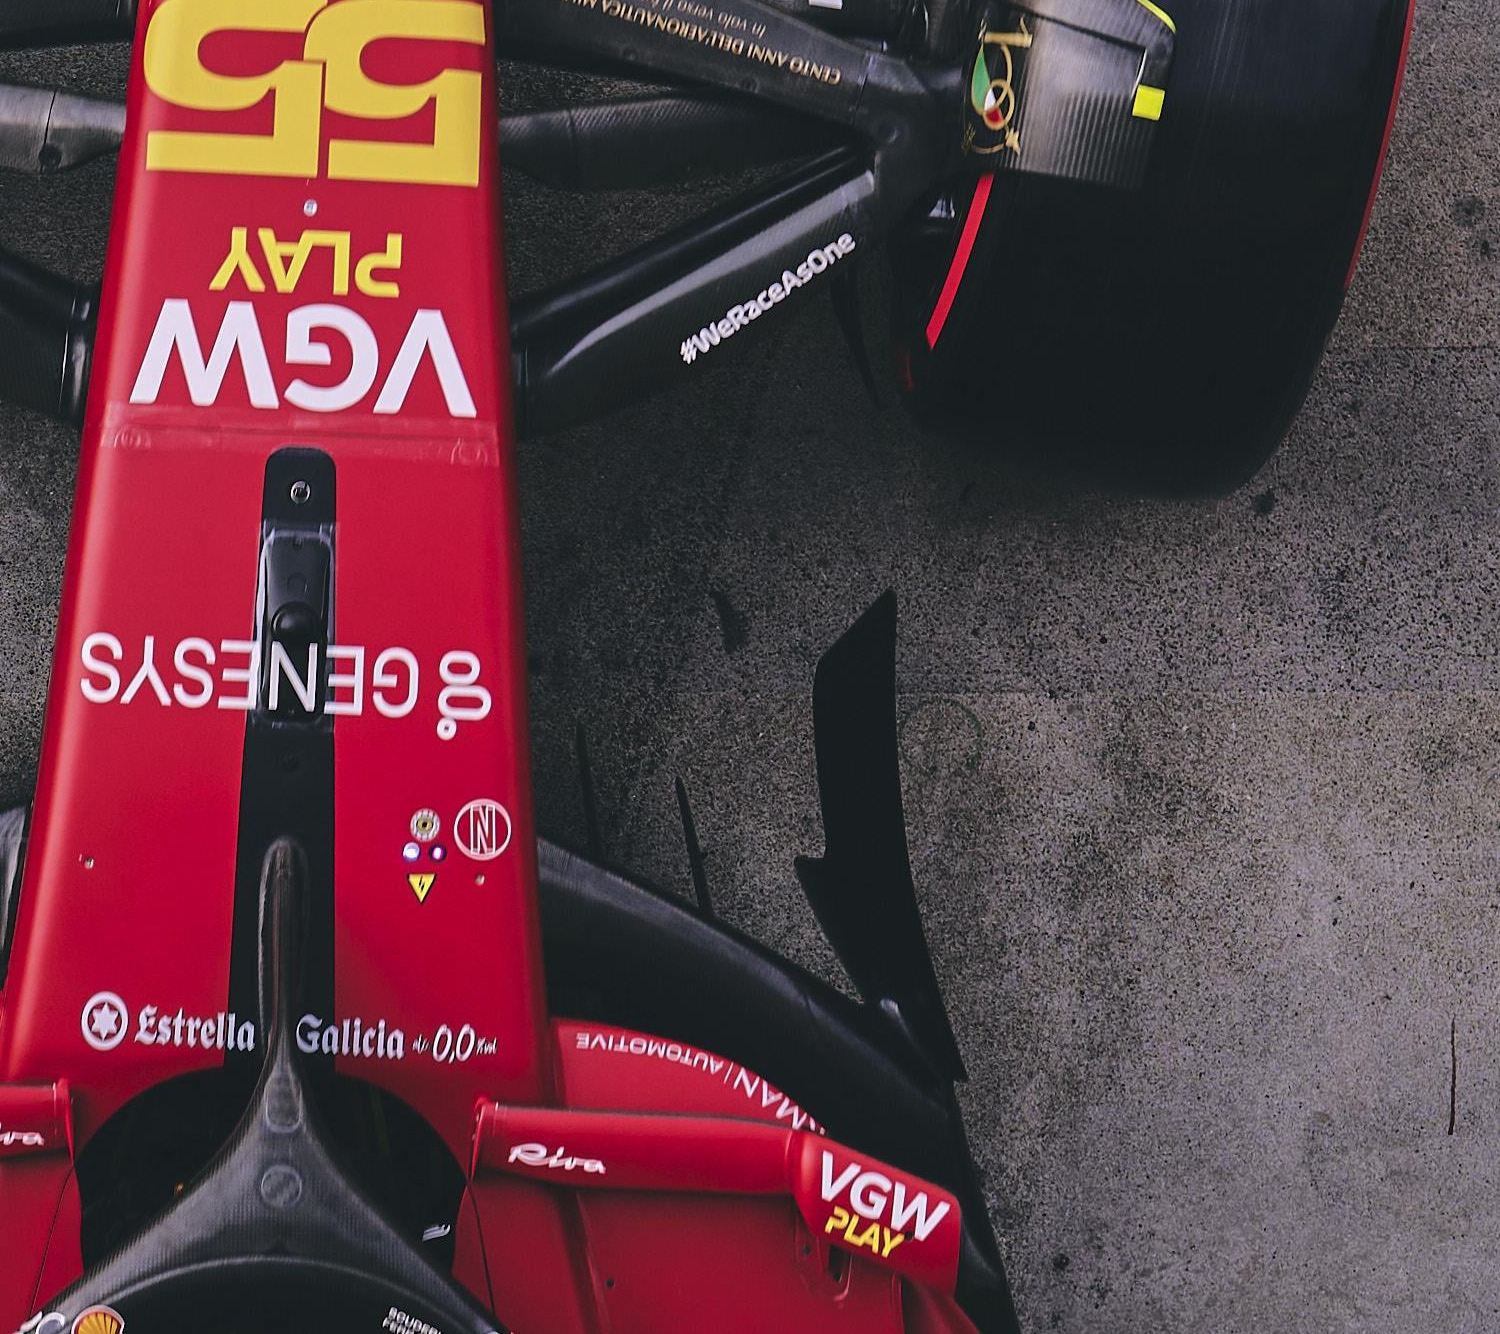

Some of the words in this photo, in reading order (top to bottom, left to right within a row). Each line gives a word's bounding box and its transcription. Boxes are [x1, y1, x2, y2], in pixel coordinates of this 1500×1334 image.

[747, 45, 789, 69] ANNI
[788, 55, 842, 86] CENTO
[209, 226, 402, 298] PLAY
[680, 232, 856, 365] #WeRaceAsOne
[128, 297, 477, 418] VGW
[80, 631, 419, 718] GENESYS
[133, 1003, 257, 1053] Estrella
[295, 1012, 405, 1060] Galicia
[575, 1032, 724, 1075] AUTOMOTIVE
[507, 1142, 606, 1176] Riva
[819, 1150, 952, 1243] VGW
[824, 1206, 906, 1259] PLAY
